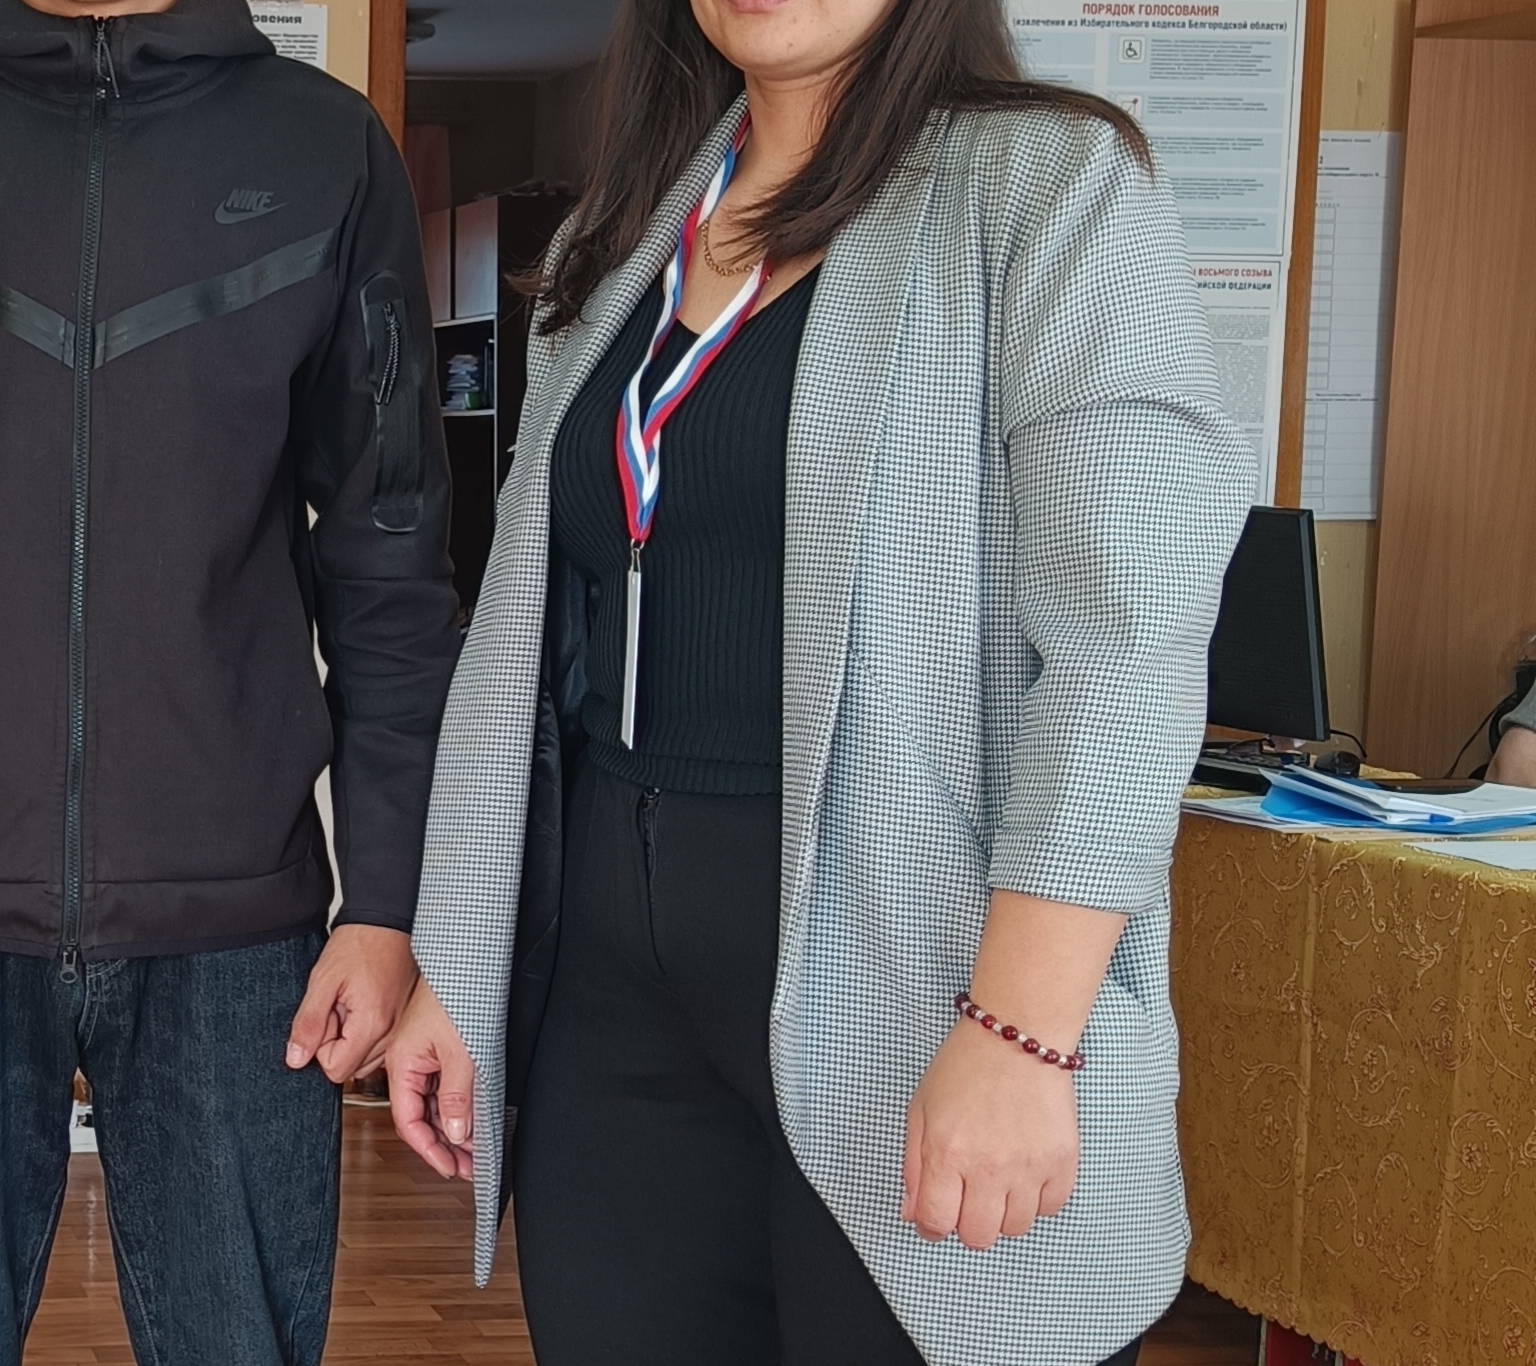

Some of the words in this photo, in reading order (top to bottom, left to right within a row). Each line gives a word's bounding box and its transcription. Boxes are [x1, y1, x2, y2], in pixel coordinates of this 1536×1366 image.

[1082, 3, 1135, 16] ПОРЯДОК
[1138, 4, 1219, 17] ГОЛОСОВАНИЯ
[252, 14, 302, 24] овения
[1080, 18, 1150, 29] Избирательного
[1152, 21, 1186, 29] кодекса
[1188, 20, 1248, 30] Белгородской
[1250, 21, 1288, 31] области)
[225, 188, 274, 212] NIKE
[1198, 268, 1240, 277] ВОСЬМОГО
[1241, 269, 1273, 277] СОЗЫВА
[1197, 280, 1227, 290] ИЙСКОЙ
[1228, 282, 1272, 290] ФЕДЕРАЦИИ
